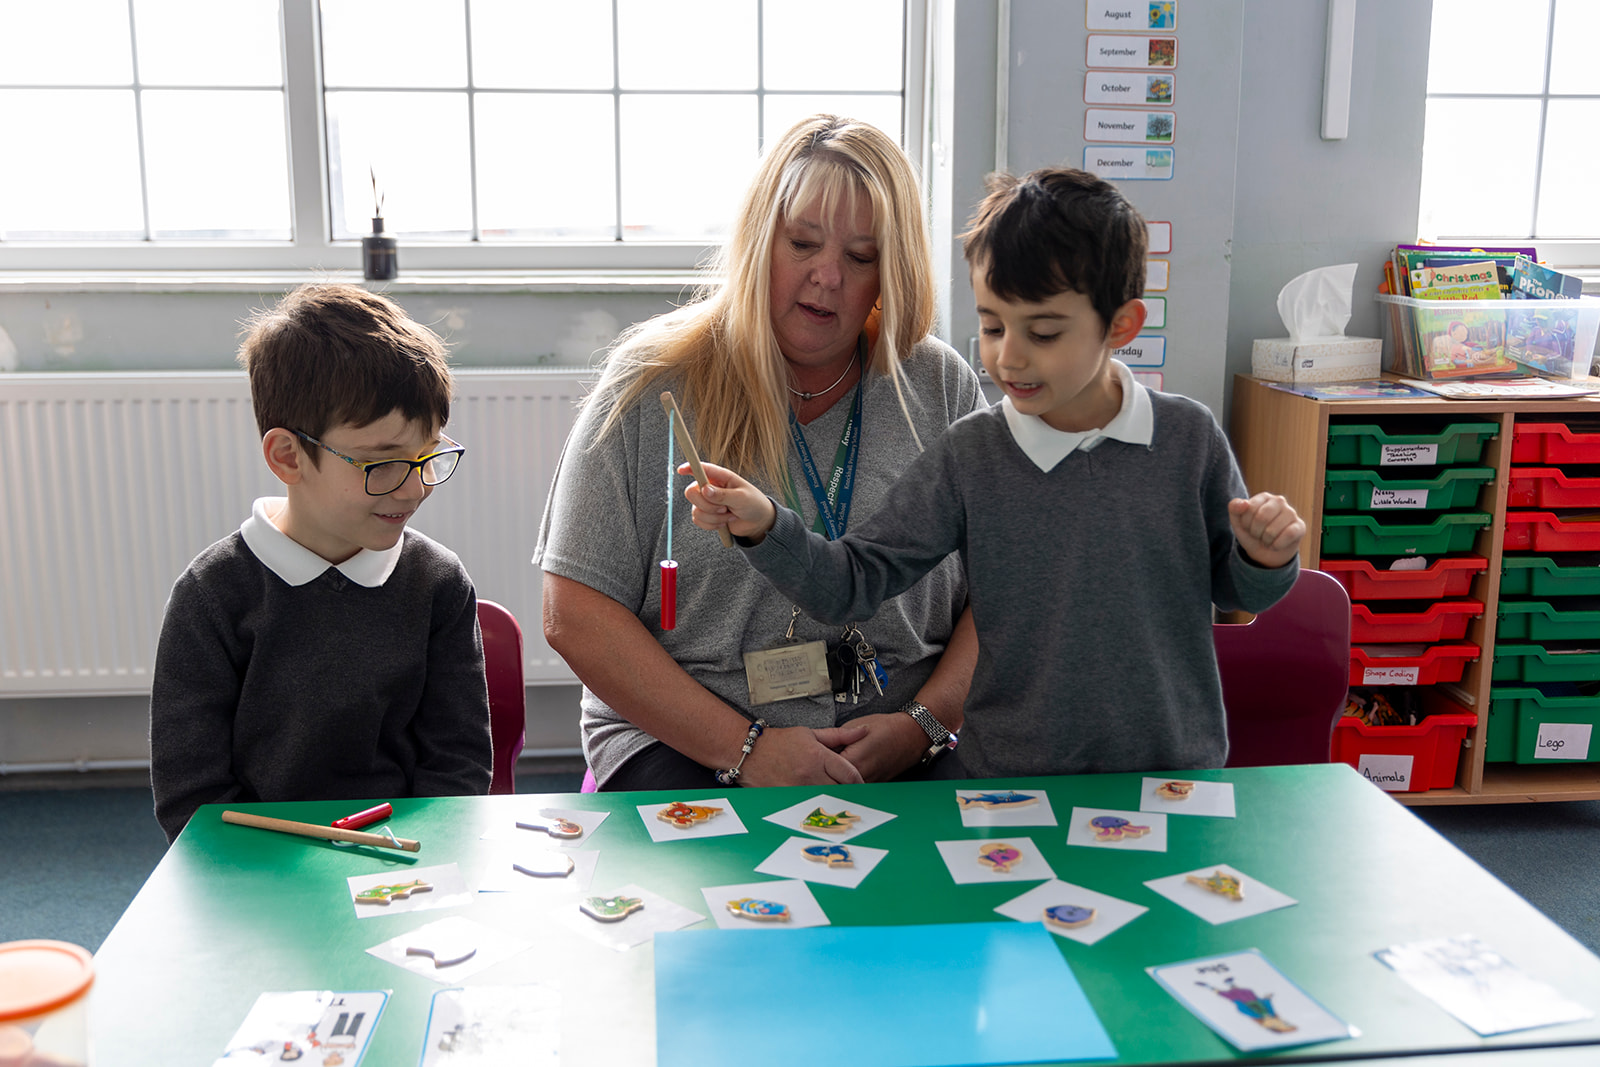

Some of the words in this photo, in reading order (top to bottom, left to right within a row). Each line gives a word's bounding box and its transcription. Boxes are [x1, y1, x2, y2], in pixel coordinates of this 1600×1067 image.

[1104, 10, 1131, 20] August
[1099, 48, 1136, 56] September
[1101, 84, 1131, 92] October
[1098, 122, 1135, 131] November
[1097, 159, 1134, 167] December
[1435, 271, 1492, 283] Christmas
[1112, 346, 1143, 358] ursday
[1365, 669, 1386, 679] Shape
[1538, 734, 1565, 752] Lego
[1363, 767, 1405, 783] Animals
